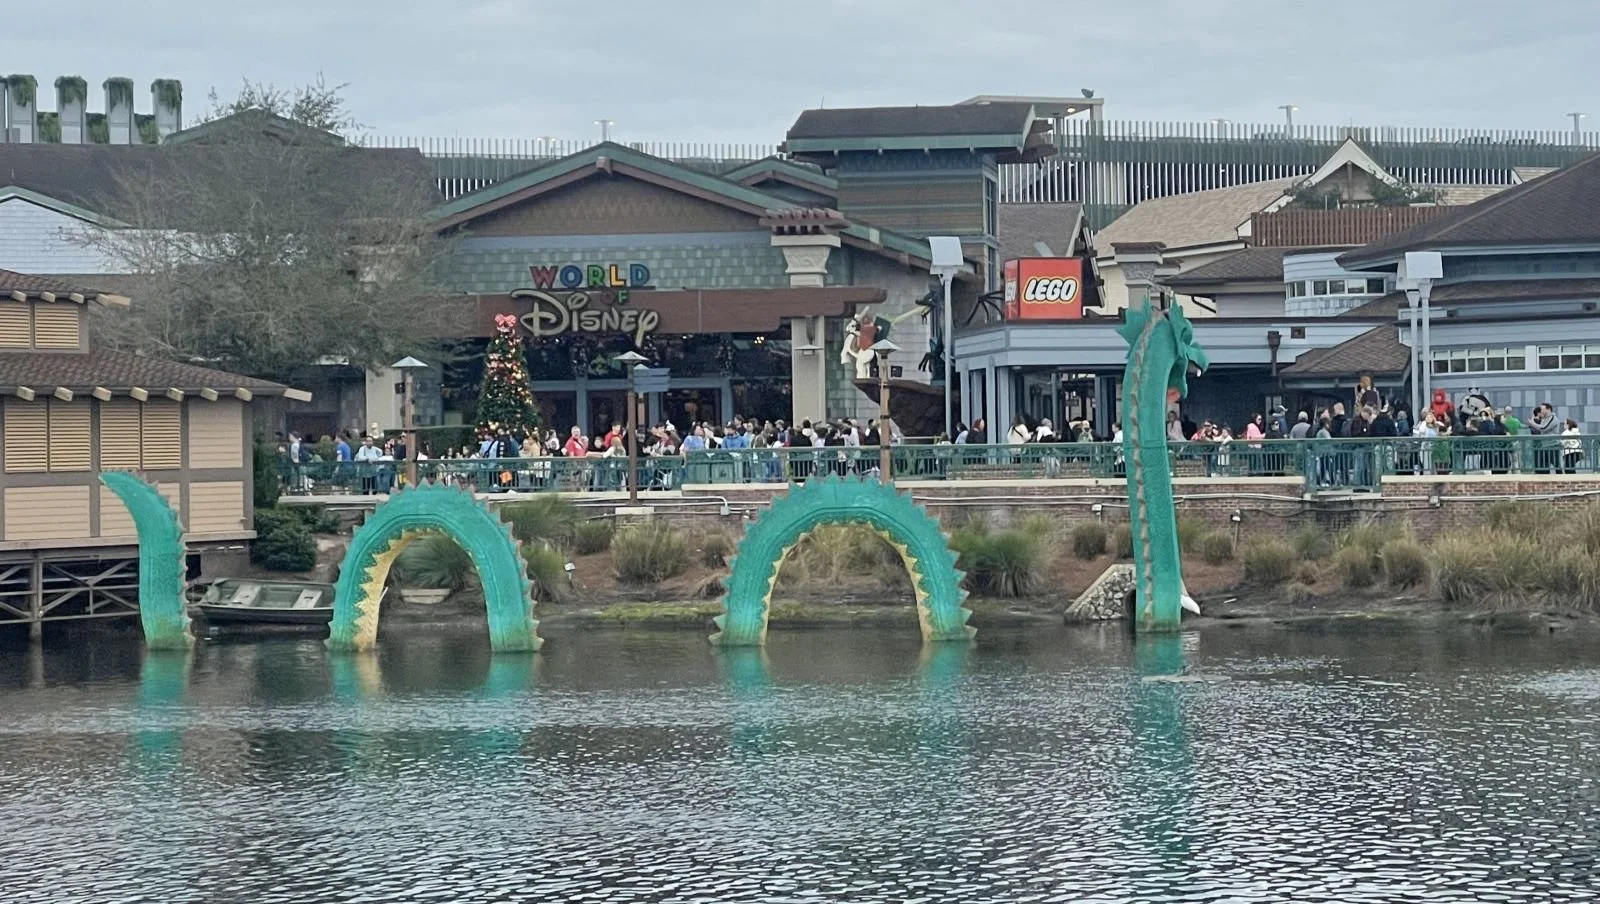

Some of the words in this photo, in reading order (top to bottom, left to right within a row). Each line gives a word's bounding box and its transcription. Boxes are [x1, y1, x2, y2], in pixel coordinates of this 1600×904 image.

[529, 264, 650, 288] WORLD
[602, 289, 629, 304] OF
[1024, 278, 1078, 301] LEGO
